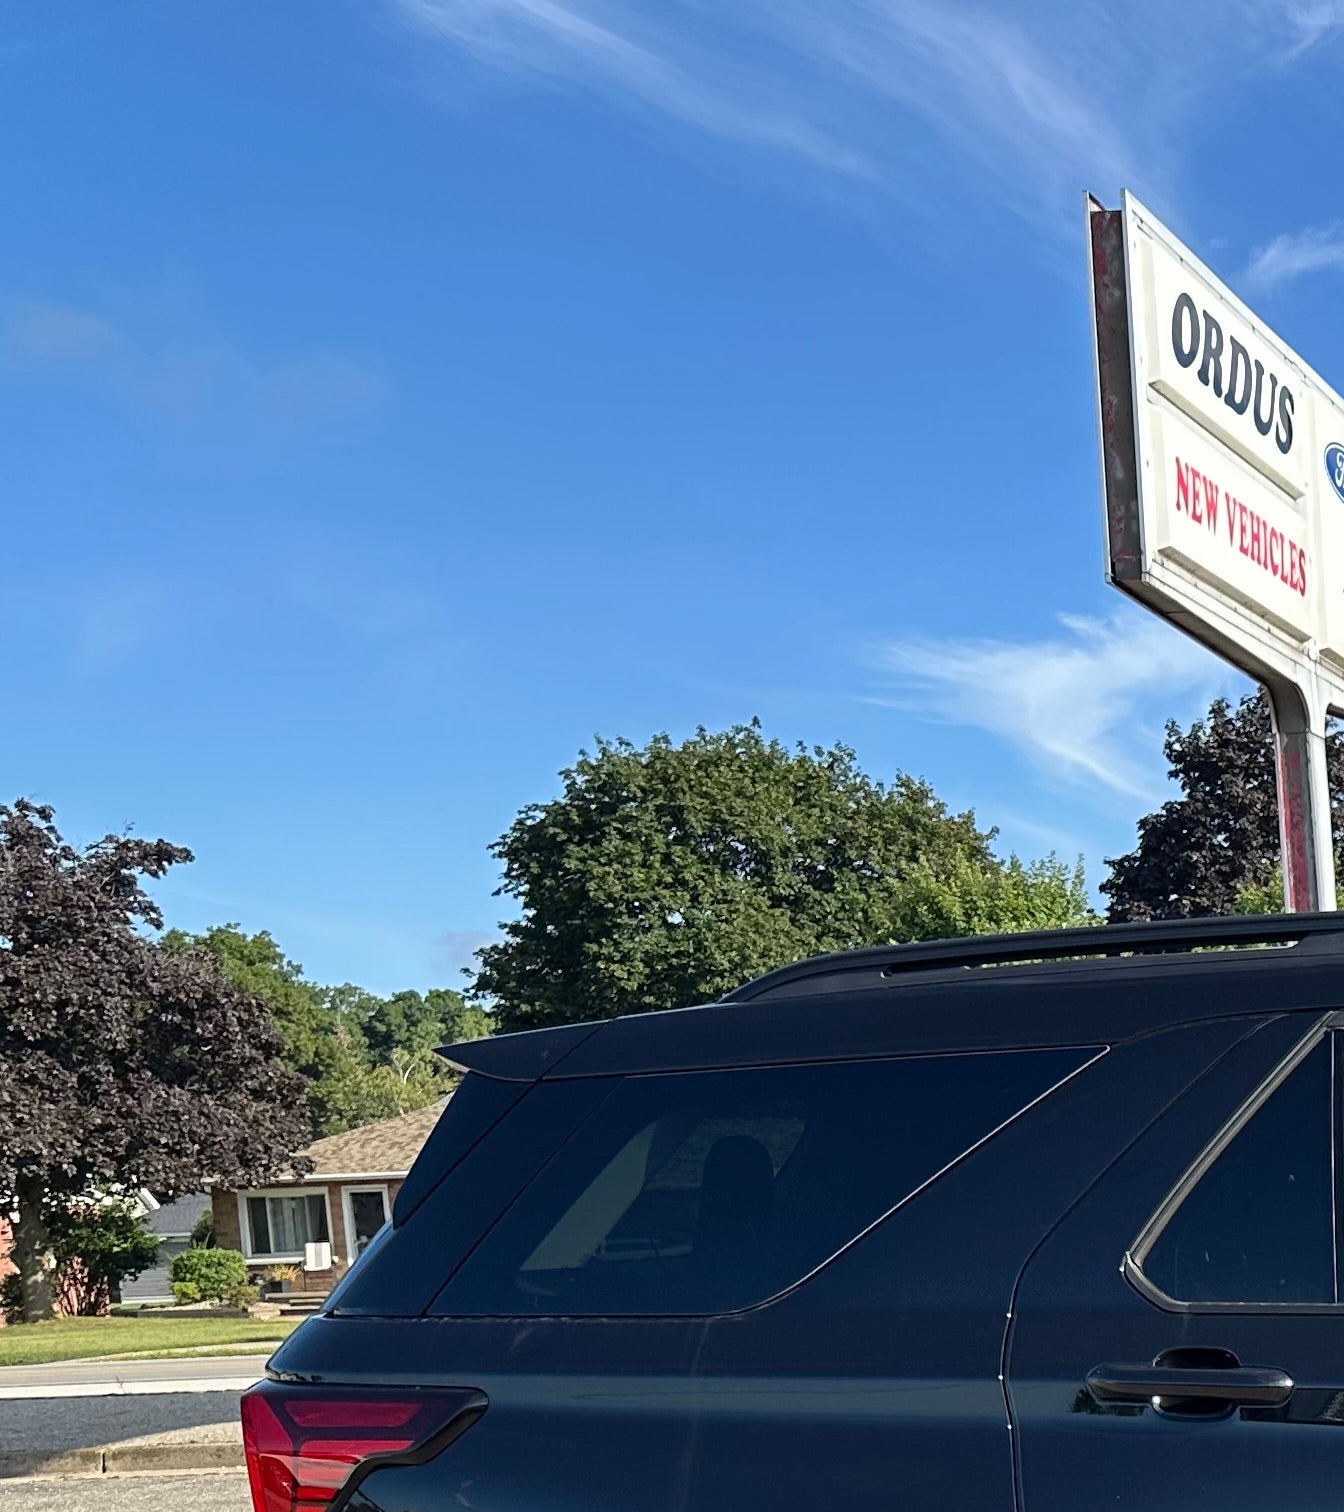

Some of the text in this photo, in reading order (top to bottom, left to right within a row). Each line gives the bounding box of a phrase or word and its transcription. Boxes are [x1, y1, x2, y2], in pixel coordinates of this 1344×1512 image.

[1171, 292, 1296, 455] ORDUS
[1175, 456, 1307, 597] NEW VEHICLES
